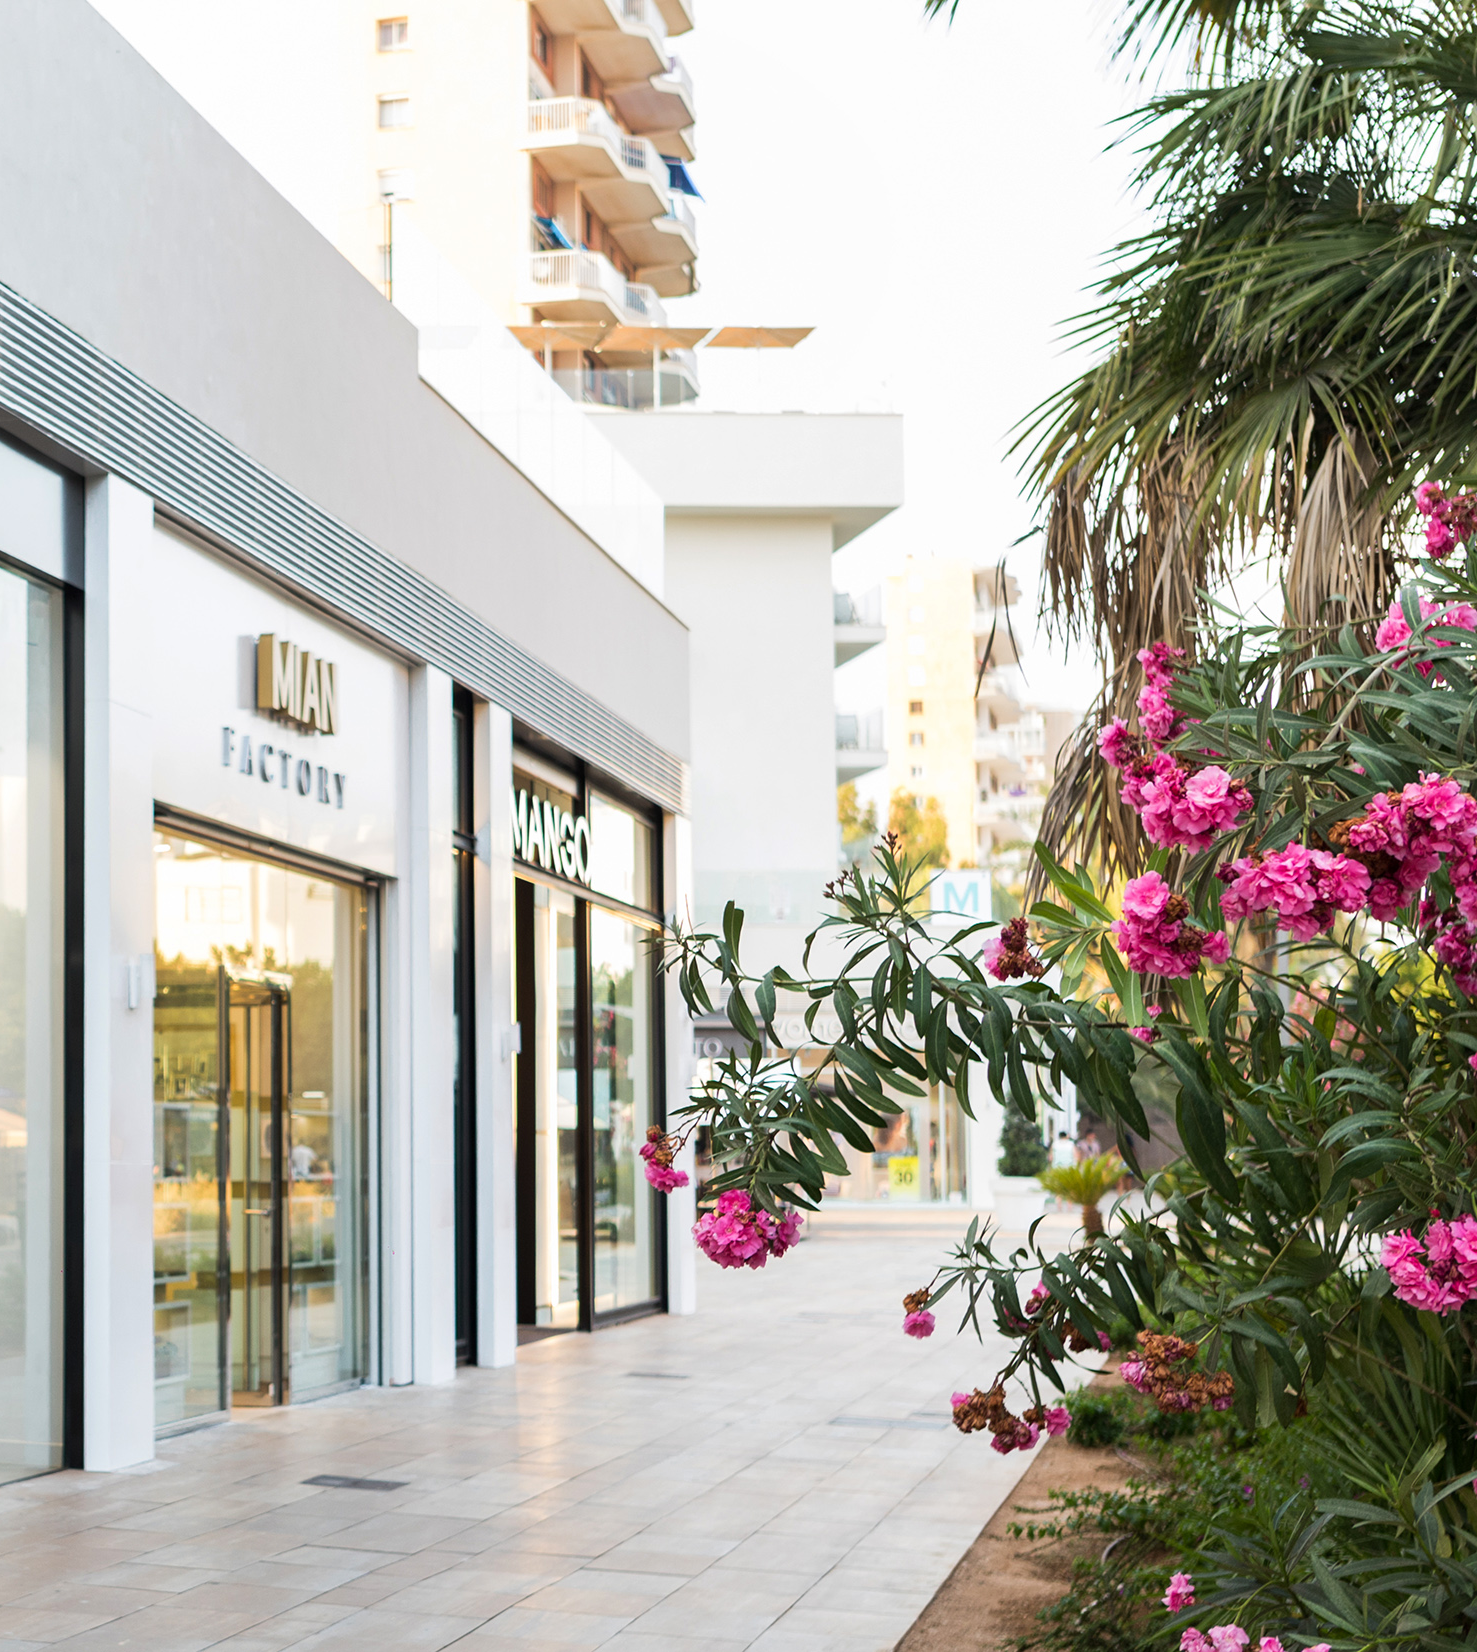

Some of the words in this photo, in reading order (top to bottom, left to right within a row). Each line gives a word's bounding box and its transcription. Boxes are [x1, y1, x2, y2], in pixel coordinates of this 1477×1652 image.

[270, 633, 338, 735] MIAN
[222, 727, 346, 810] FACTORY
[509, 784, 592, 888] MANGO
[944, 882, 979, 912] M
[894, 1168, 913, 1186] 30
